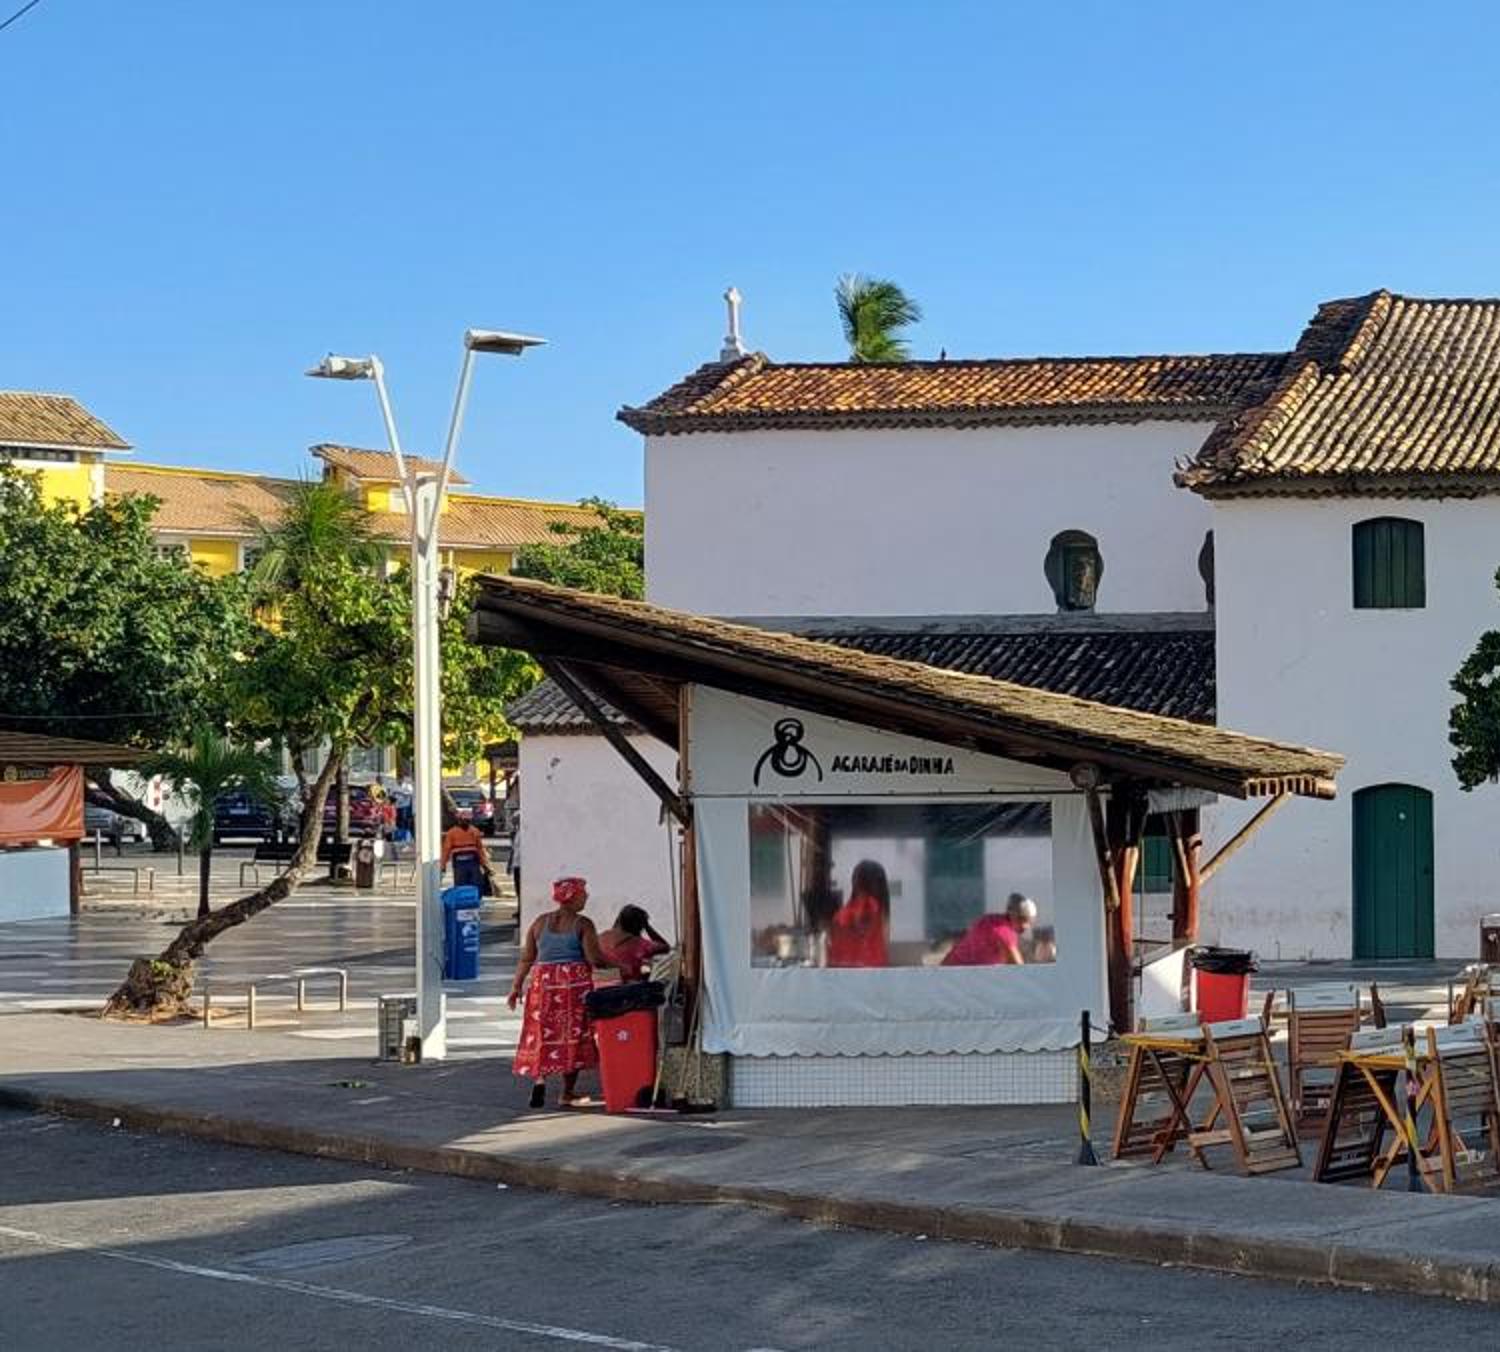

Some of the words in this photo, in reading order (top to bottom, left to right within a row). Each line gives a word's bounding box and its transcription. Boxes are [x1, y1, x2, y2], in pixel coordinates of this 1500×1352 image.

[832, 754, 894, 773] ACARAJÉ
[895, 759, 909, 771] DA
[909, 755, 954, 775] DINHA
